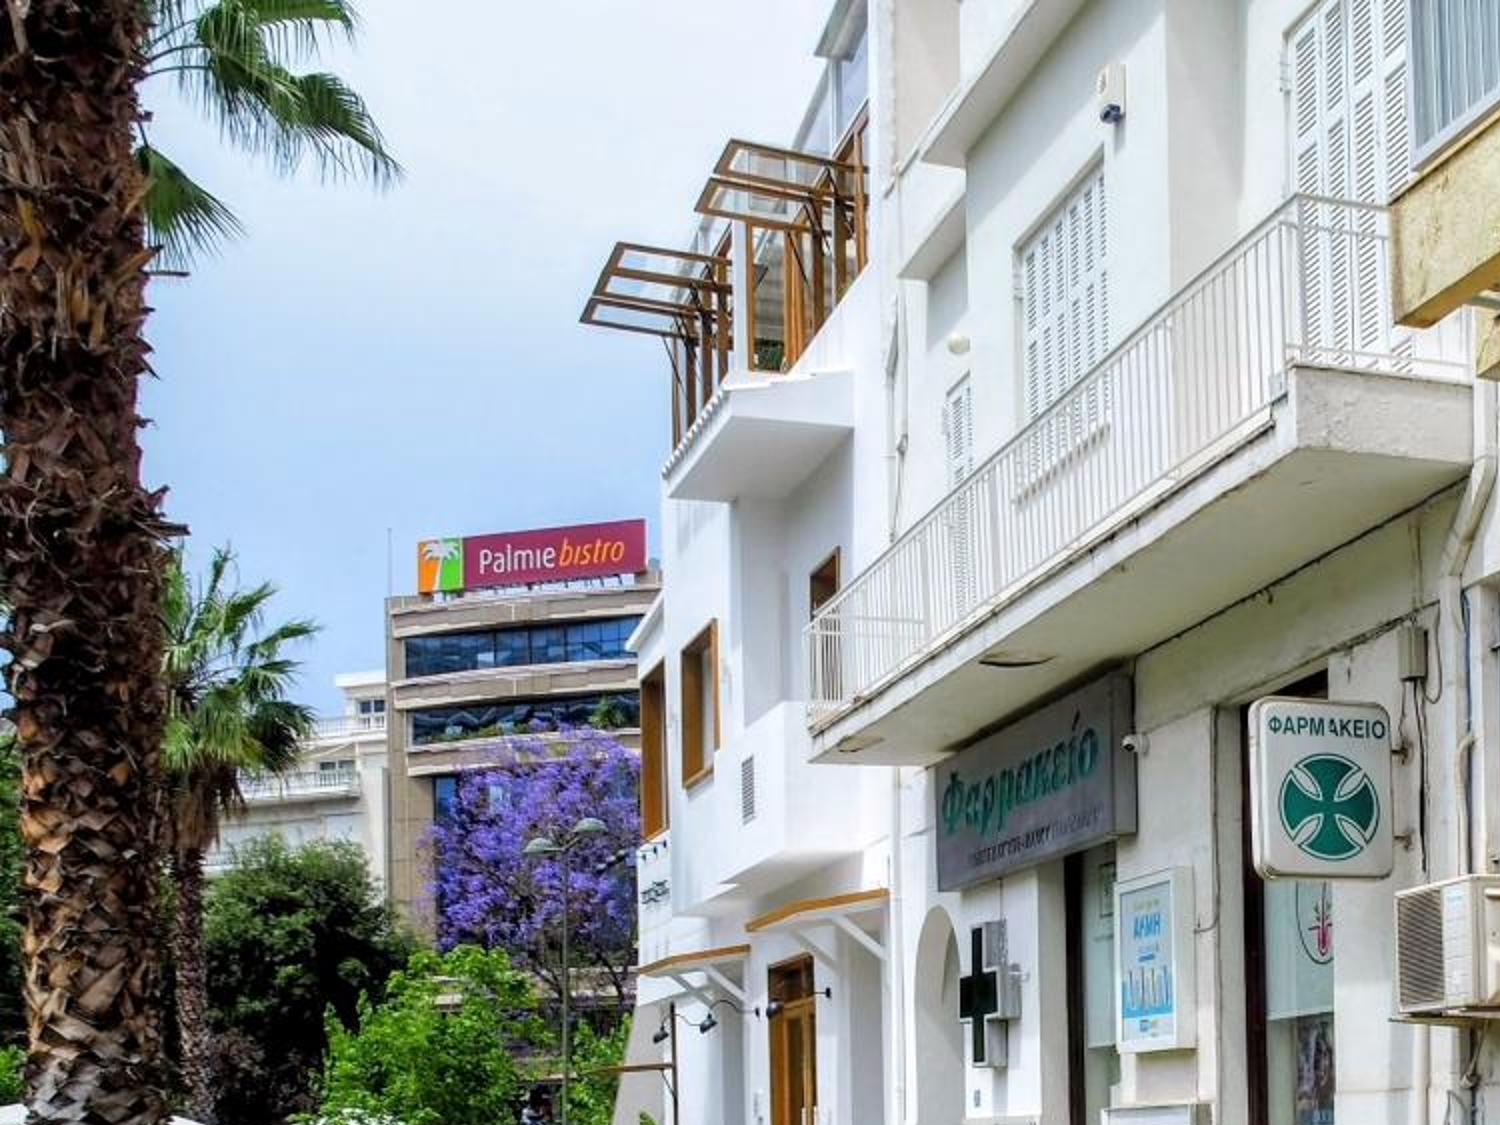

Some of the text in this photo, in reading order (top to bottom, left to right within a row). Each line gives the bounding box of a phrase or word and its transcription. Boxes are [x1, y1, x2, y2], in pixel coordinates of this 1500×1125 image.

[479, 537, 625, 574] Palmie bistro
[1267, 714, 1386, 739] ΦΑΡΜΑΚΕΙΟ
[942, 709, 1099, 836] Φαρμακείο
